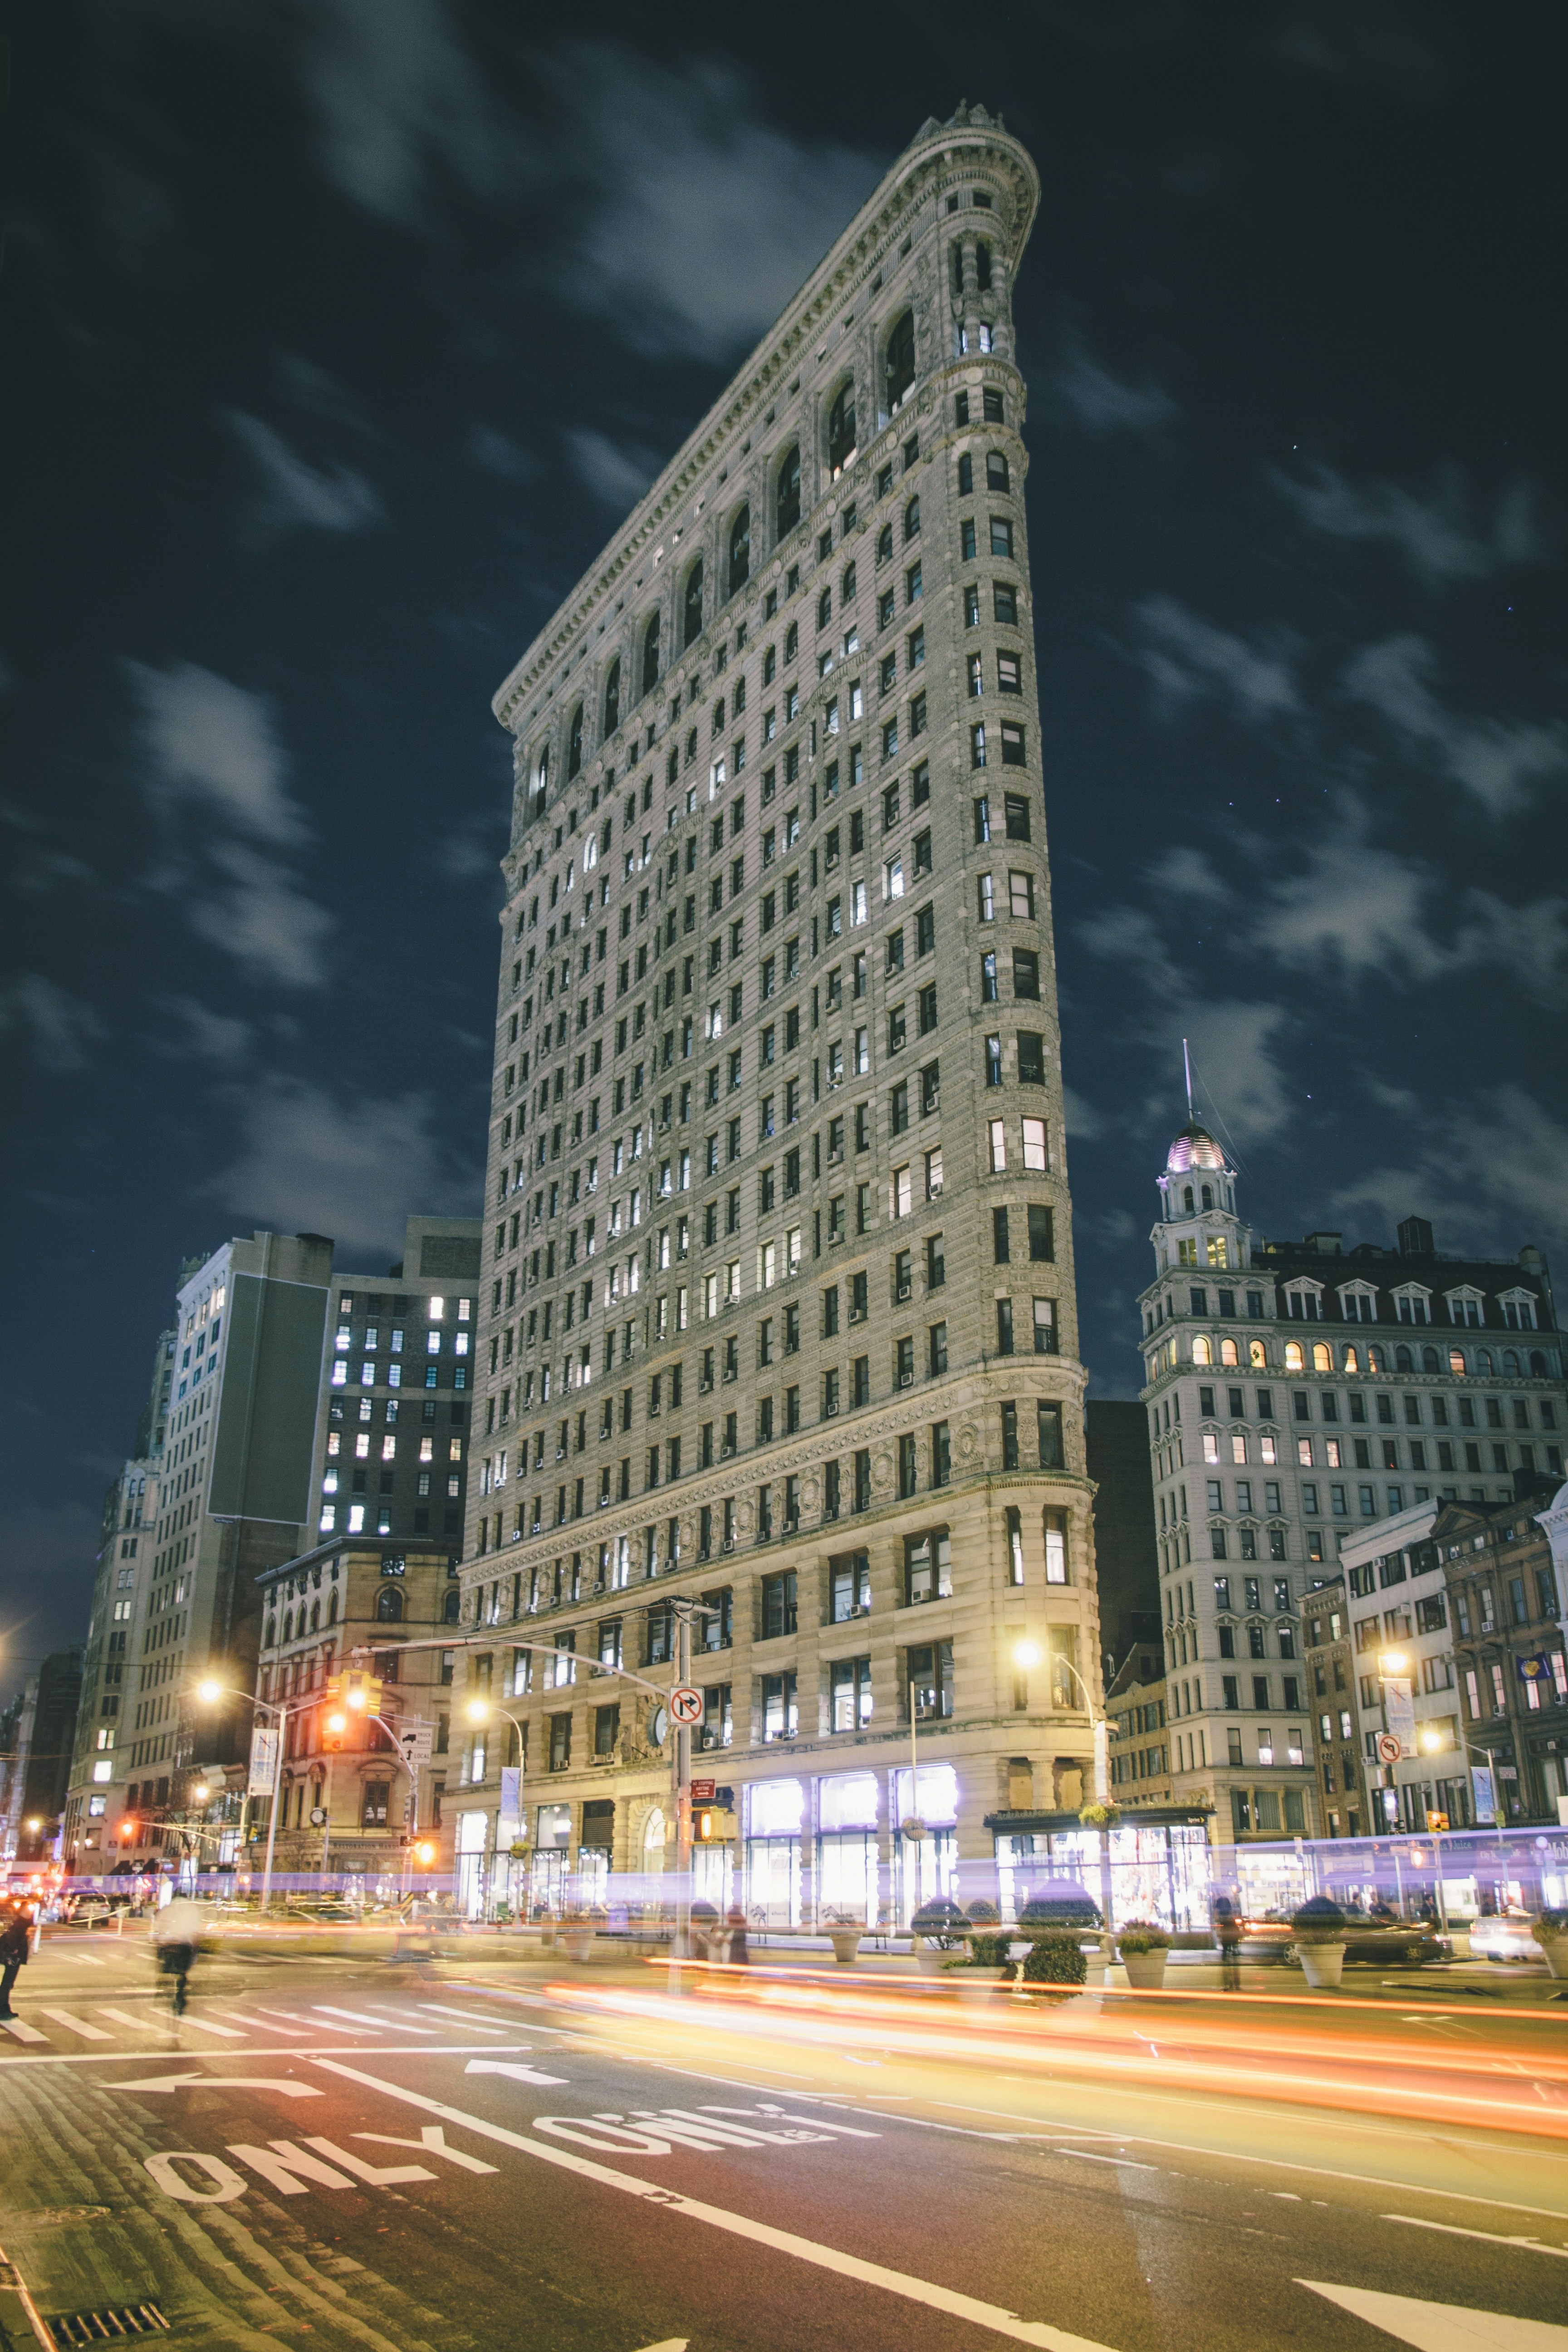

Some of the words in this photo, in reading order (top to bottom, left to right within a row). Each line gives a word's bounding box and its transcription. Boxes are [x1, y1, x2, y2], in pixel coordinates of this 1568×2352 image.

[1453, 1839, 1472, 1849] Juice
[532, 2104, 883, 2156] ONLY
[143, 2127, 500, 2206] ONLY
